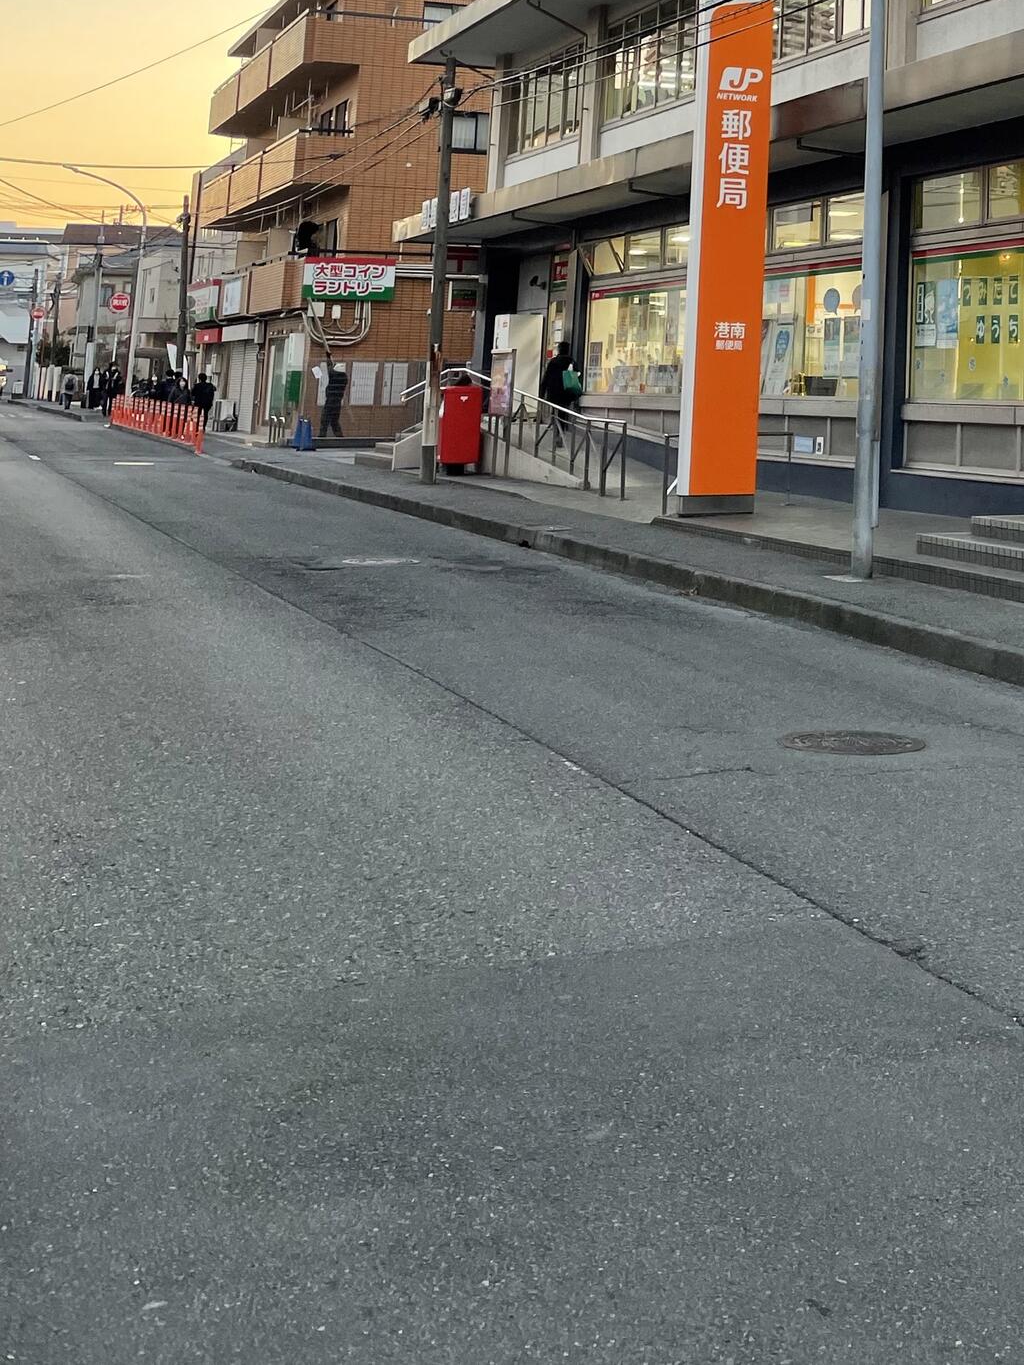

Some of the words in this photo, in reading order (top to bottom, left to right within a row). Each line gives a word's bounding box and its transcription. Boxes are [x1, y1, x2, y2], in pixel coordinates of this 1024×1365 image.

[719, 66, 763, 92] JP
[716, 92, 758, 103] NETWORK
[716, 109, 752, 210] 郵便局
[315, 263, 386, 280] 大型コイン
[713, 321, 747, 339] 港南
[714, 340, 743, 351] 郵便局
